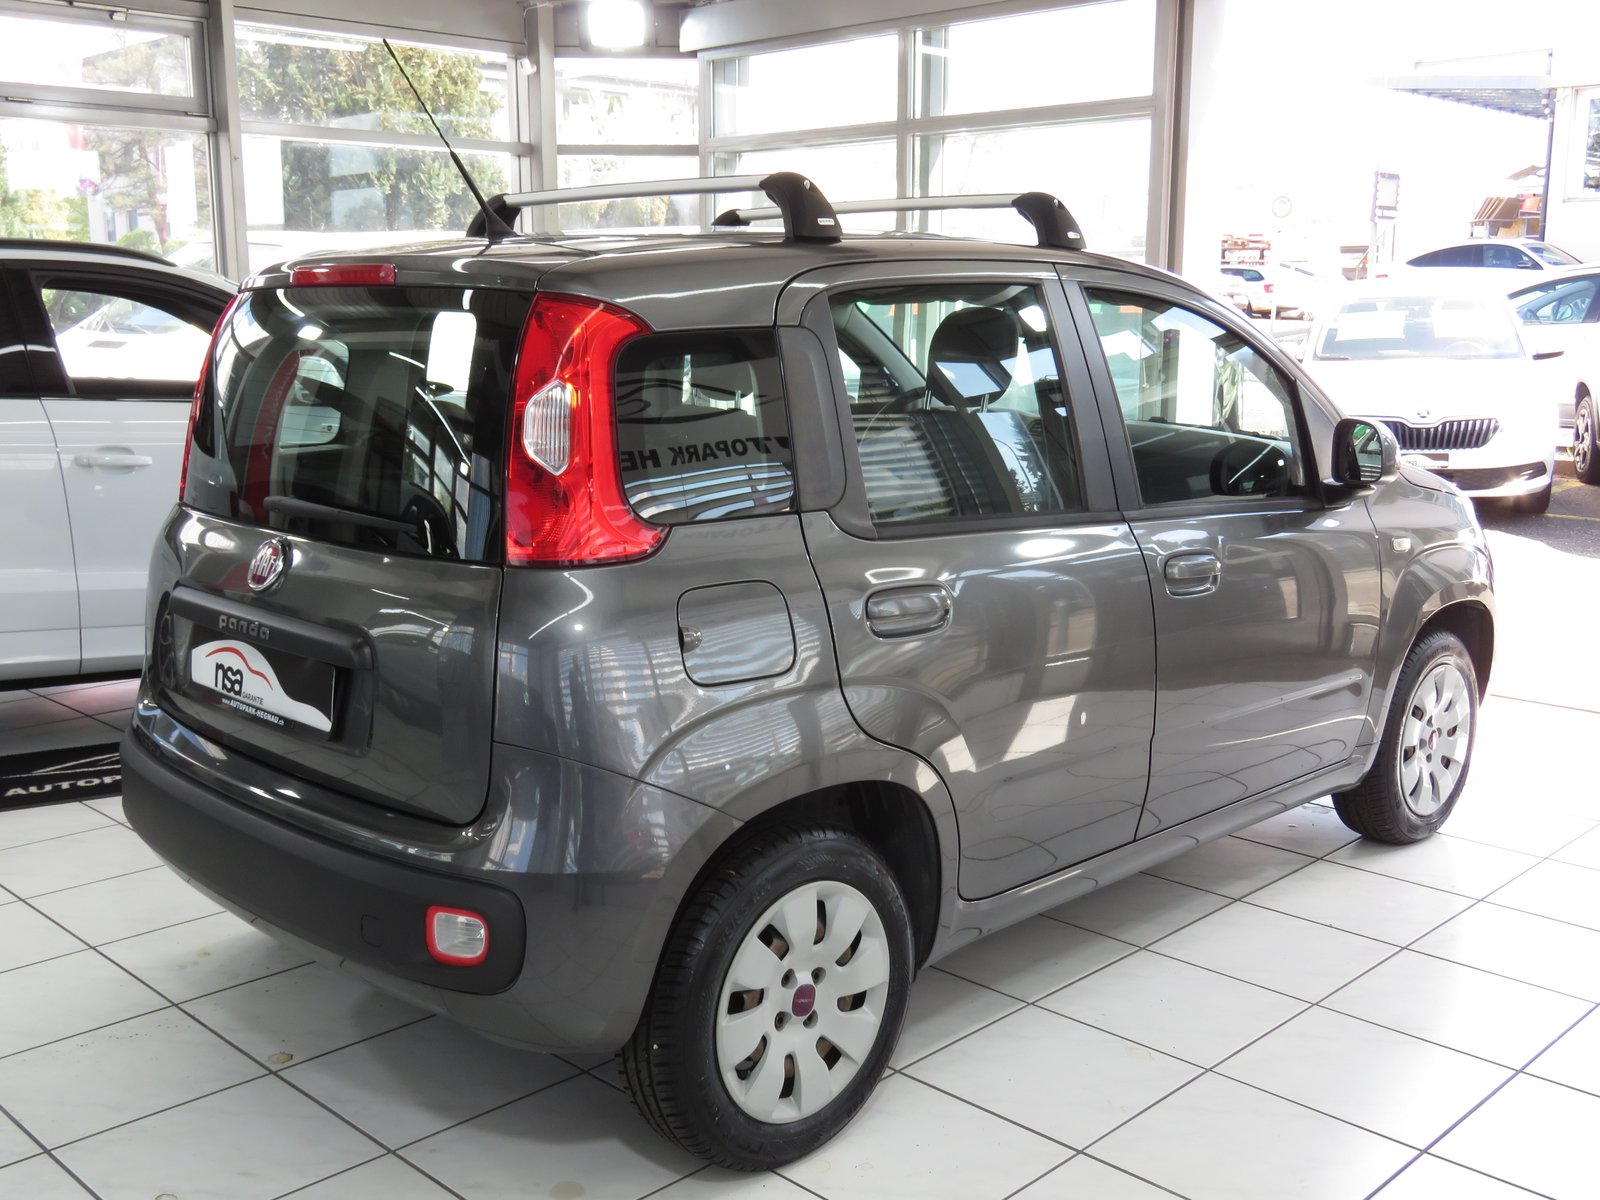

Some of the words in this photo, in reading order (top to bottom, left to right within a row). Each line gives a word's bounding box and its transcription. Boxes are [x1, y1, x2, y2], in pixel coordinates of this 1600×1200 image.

[253, 549, 279, 577] FIAT
[219, 614, 270, 640] panda
[215, 662, 244, 697] nsa
[242, 691, 264, 706] GARANTIE
[5, 775, 122, 796] AUTOP
